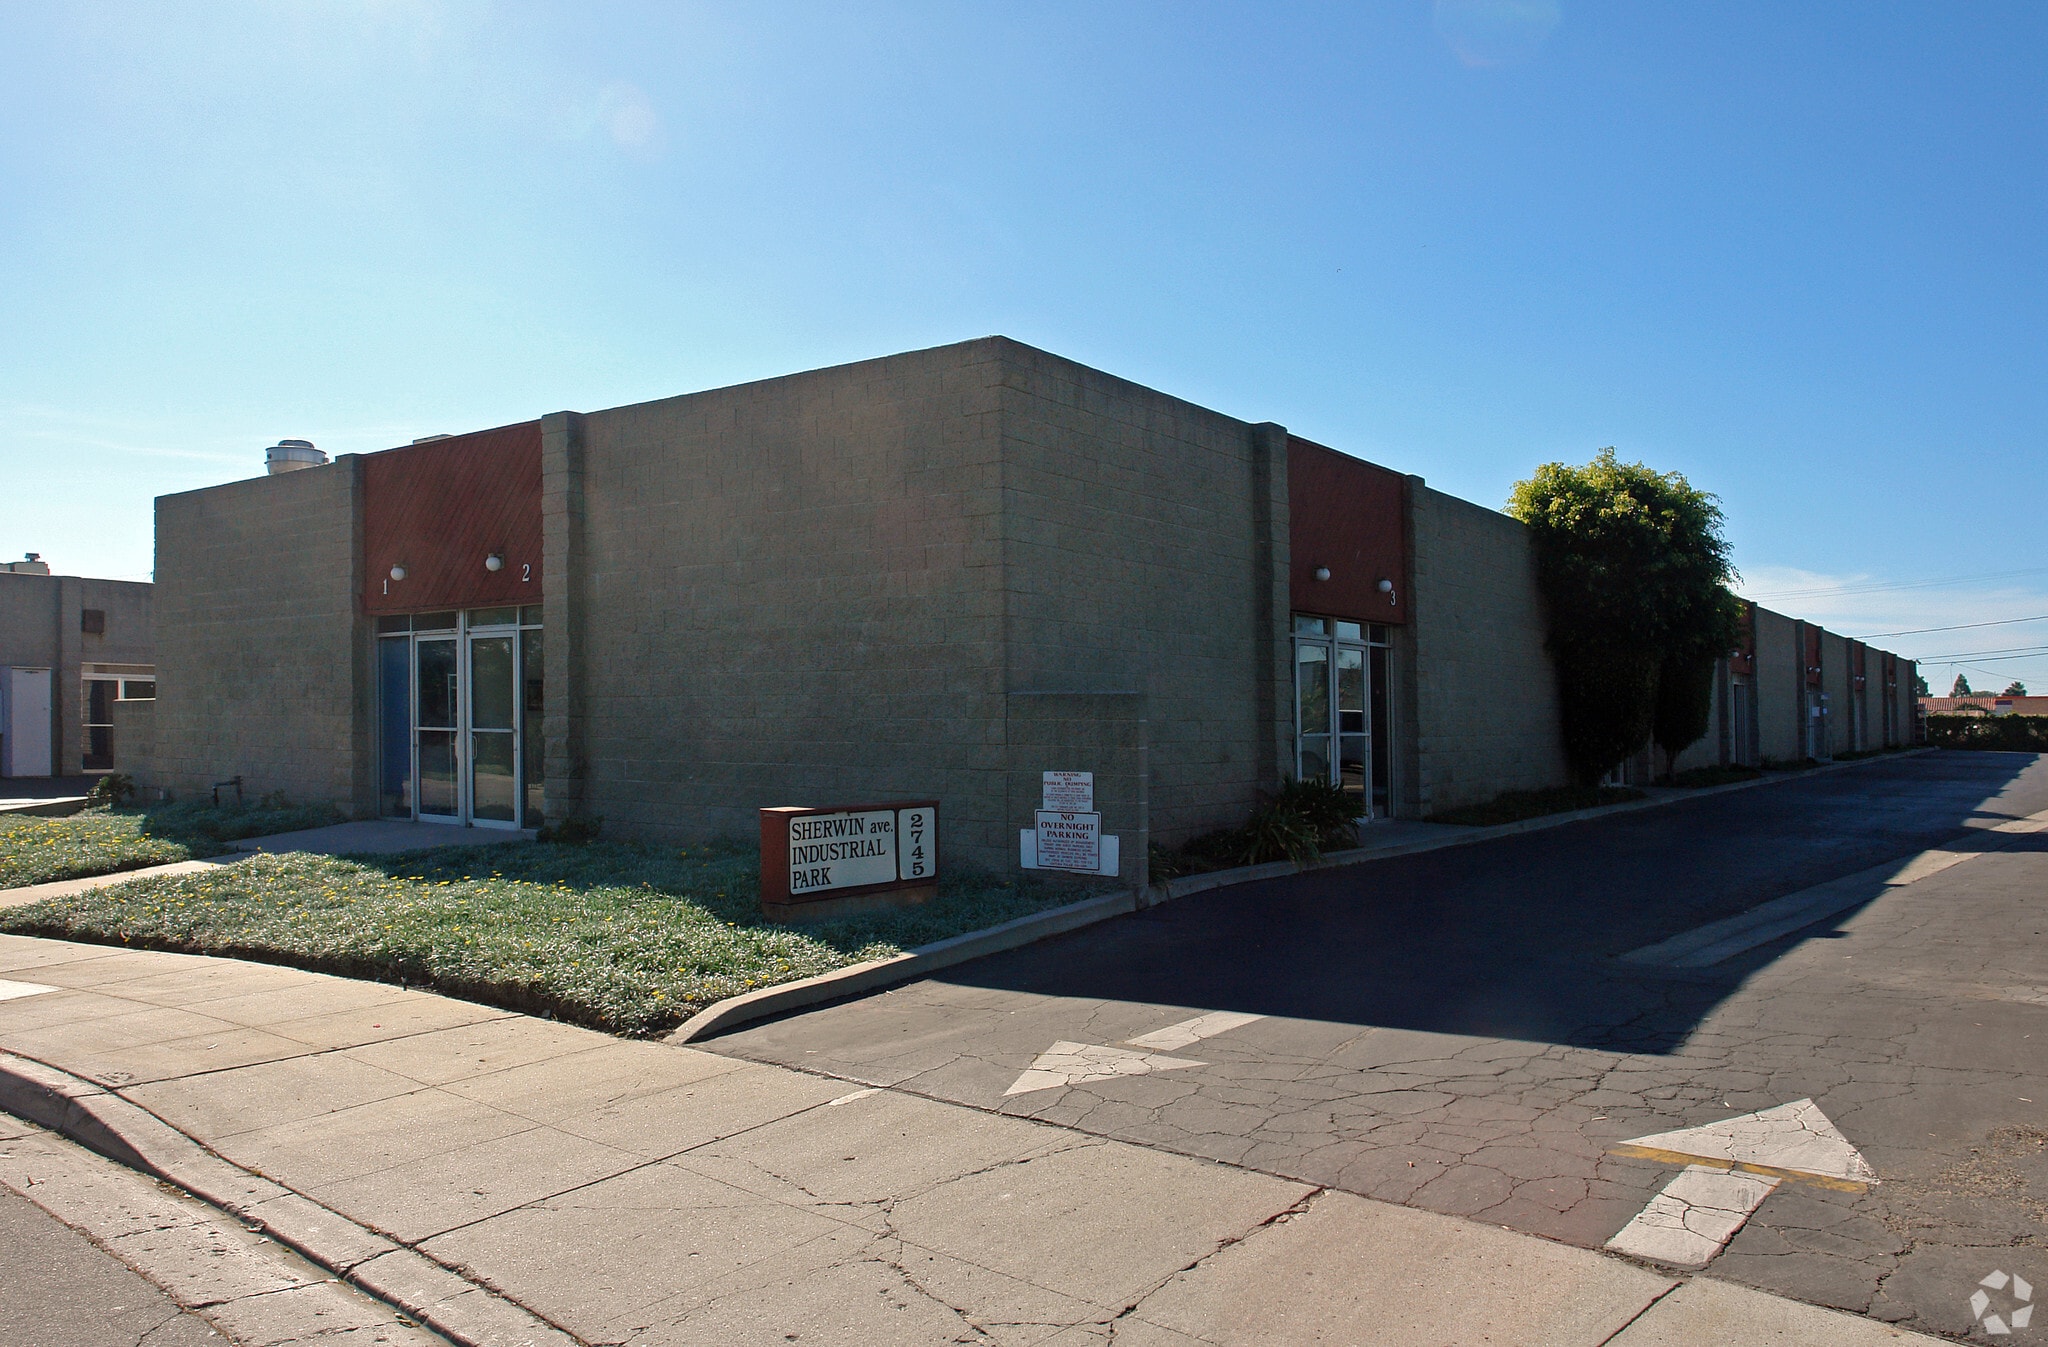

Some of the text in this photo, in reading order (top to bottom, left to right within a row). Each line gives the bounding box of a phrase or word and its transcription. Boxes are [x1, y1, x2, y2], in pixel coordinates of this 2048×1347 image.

[522, 563, 531, 582] 2
[383, 578, 389, 595] 1
[1390, 590, 1396, 606] 3
[1060, 813, 1075, 821] NO
[791, 817, 894, 841] SHERWIN ave.
[1040, 821, 1095, 831] OVERNIGHT
[1046, 830, 1089, 840] PARKING
[791, 838, 886, 866] INDUSTRIAL
[792, 866, 832, 890] PARK
